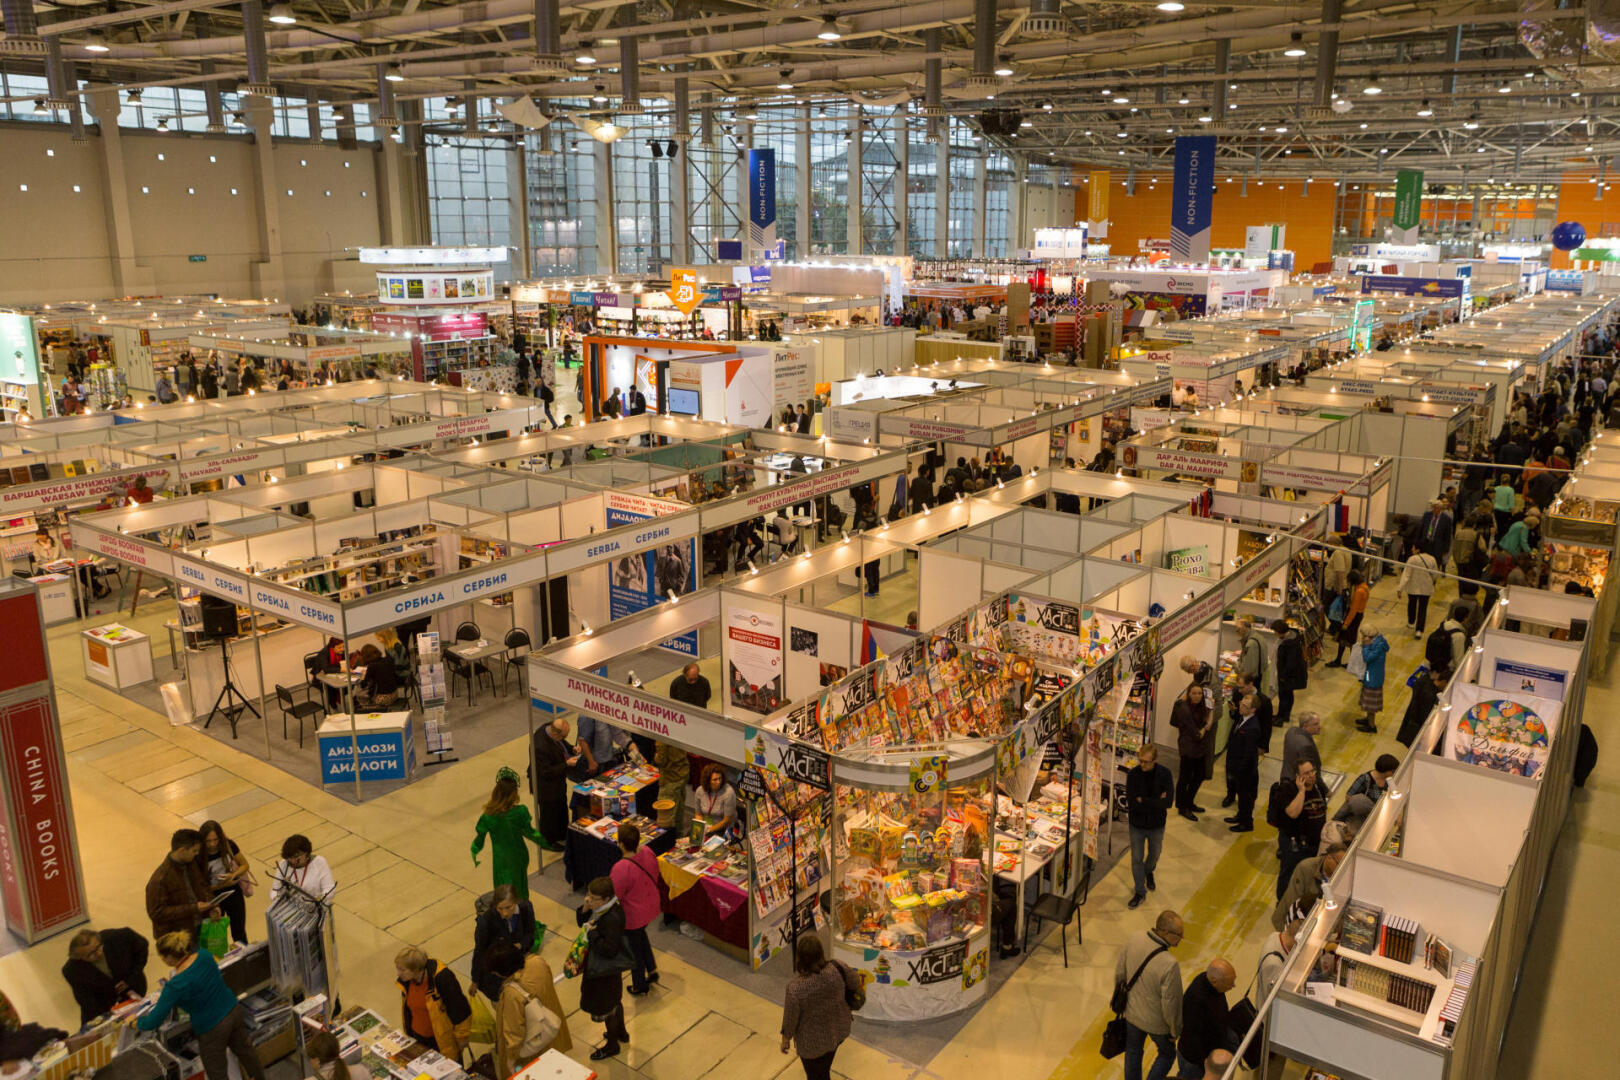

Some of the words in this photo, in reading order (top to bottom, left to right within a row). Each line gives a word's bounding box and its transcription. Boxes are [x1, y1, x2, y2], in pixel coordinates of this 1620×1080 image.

[1187, 150, 1200, 225] NON-FICTION
[910, 430, 930, 438] RUSLAN
[932, 426, 966, 434] PUBLISHING
[1156, 453, 1171, 461] ДАР
[1172, 455, 1188, 463] АЛЬ
[1159, 461, 1174, 469] DAR
[1176, 463, 1185, 471] AL
[3, 483, 73, 502] ВАРШАВСКАЯ
[41, 489, 86, 504] WARSAW
[747, 491, 775, 506] ИНСТИТУТ
[635, 527, 670, 544] СЕРБИЯ
[587, 541, 621, 558] SERBIA
[181, 565, 205, 581] SERBIA
[214, 577, 243, 595] СЕРБИЯ
[462, 573, 508, 594] СЕРБИЯ
[256, 591, 290, 610] СРБИЈА
[394, 592, 445, 614] СРБИЈА
[300, 605, 335, 624] СЕРБИЯ
[663, 640, 692, 653] ЕРБИЯ
[568, 678, 630, 707] ЛАТИНСКАЯ
[633, 699, 687, 726] АМЕРИКА
[584, 698, 628, 721] AMERICA
[632, 713, 670, 737] LATINA
[25, 746, 47, 804] CHINA
[36, 818, 60, 881] BOOKS
